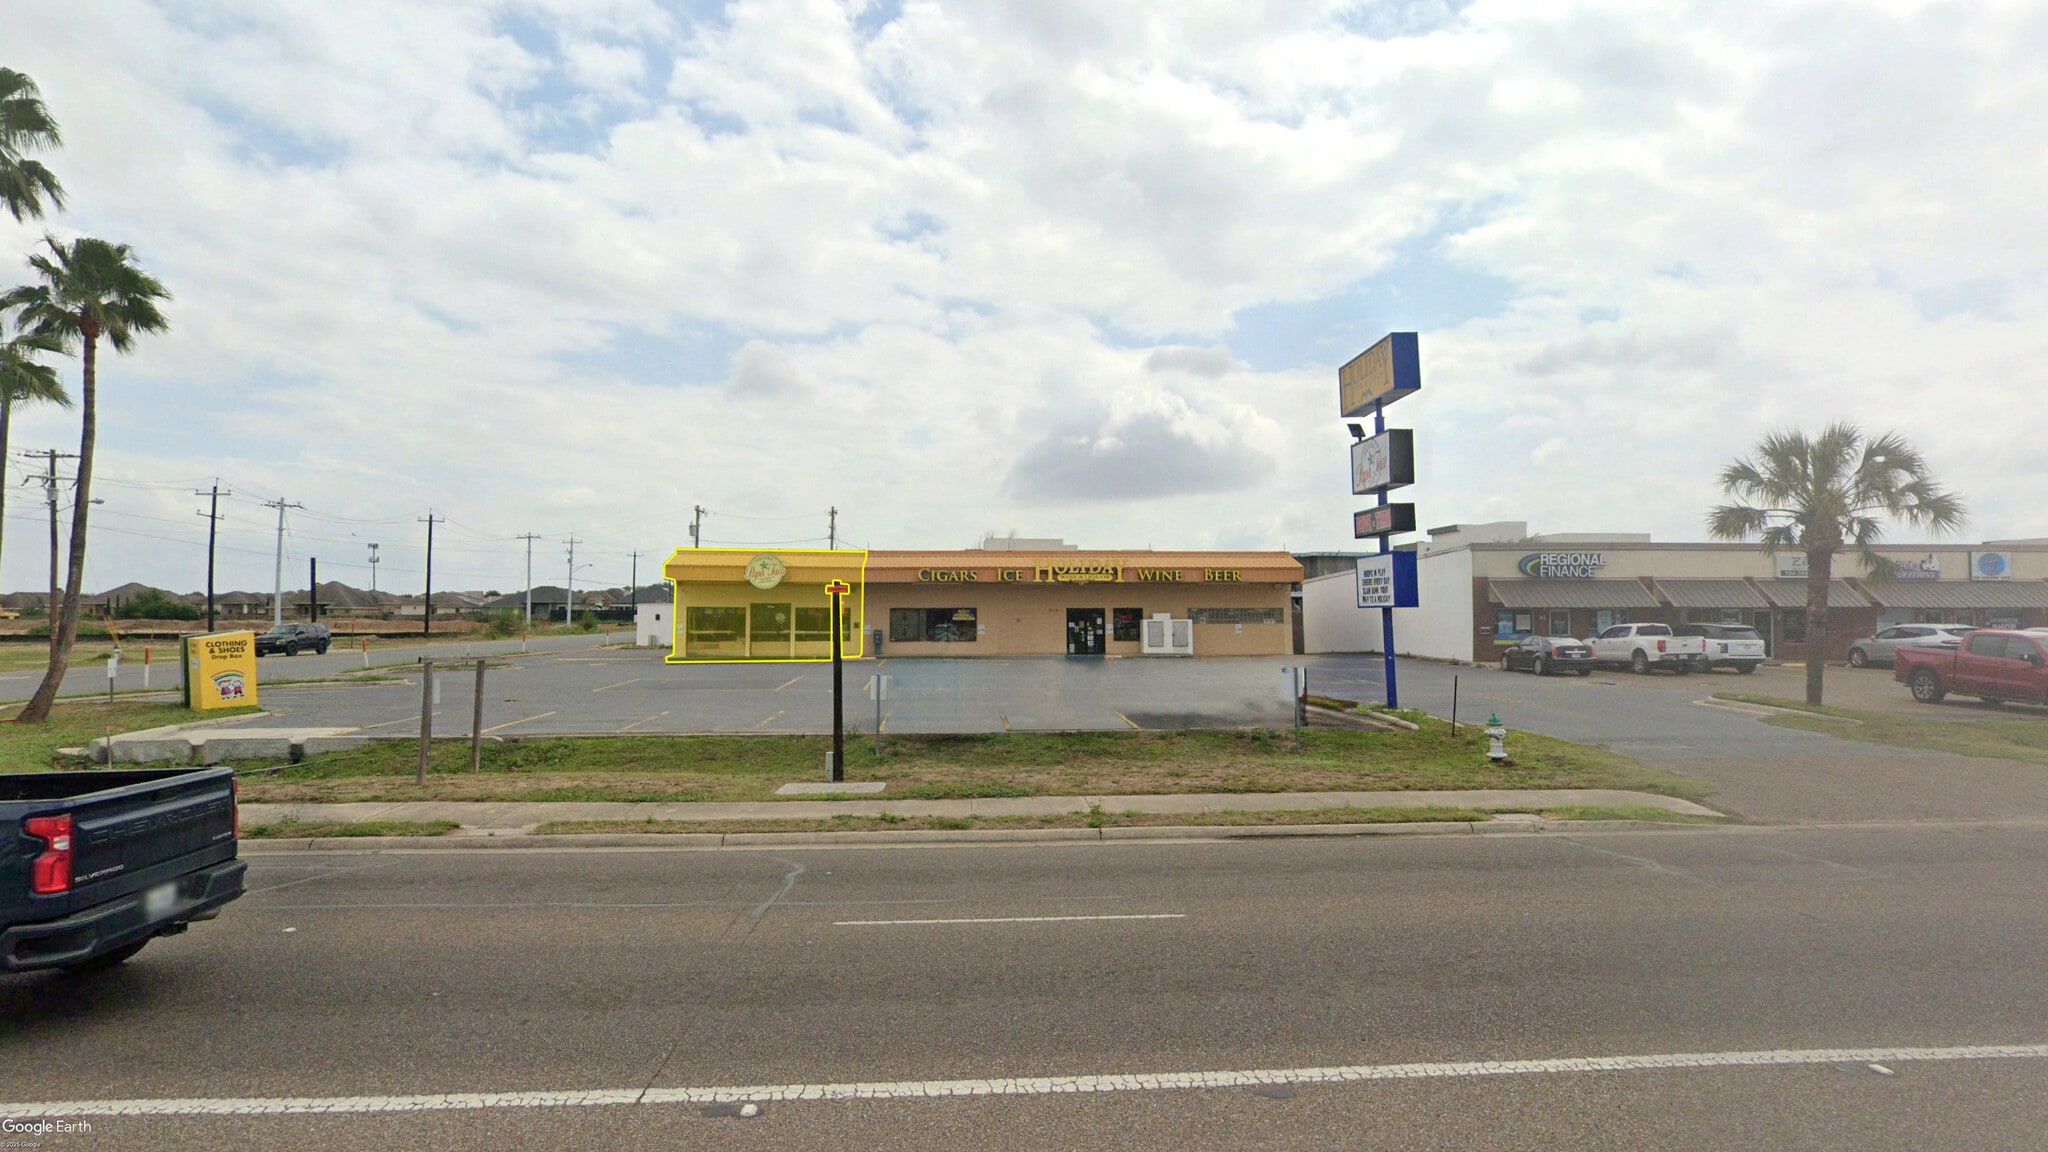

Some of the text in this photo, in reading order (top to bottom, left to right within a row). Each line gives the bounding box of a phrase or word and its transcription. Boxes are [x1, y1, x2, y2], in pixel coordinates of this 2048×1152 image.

[1540, 553, 1607, 566] REGIONAL
[918, 567, 1243, 582] CIGARS ICE WINE BEER
[1033, 558, 1129, 583] HOLIDAY
[1540, 565, 1599, 577] FINANCE
[205, 640, 248, 648] CLOTHING
[218, 646, 245, 654] SHOES
[74, 864, 125, 884] SILVERADO
